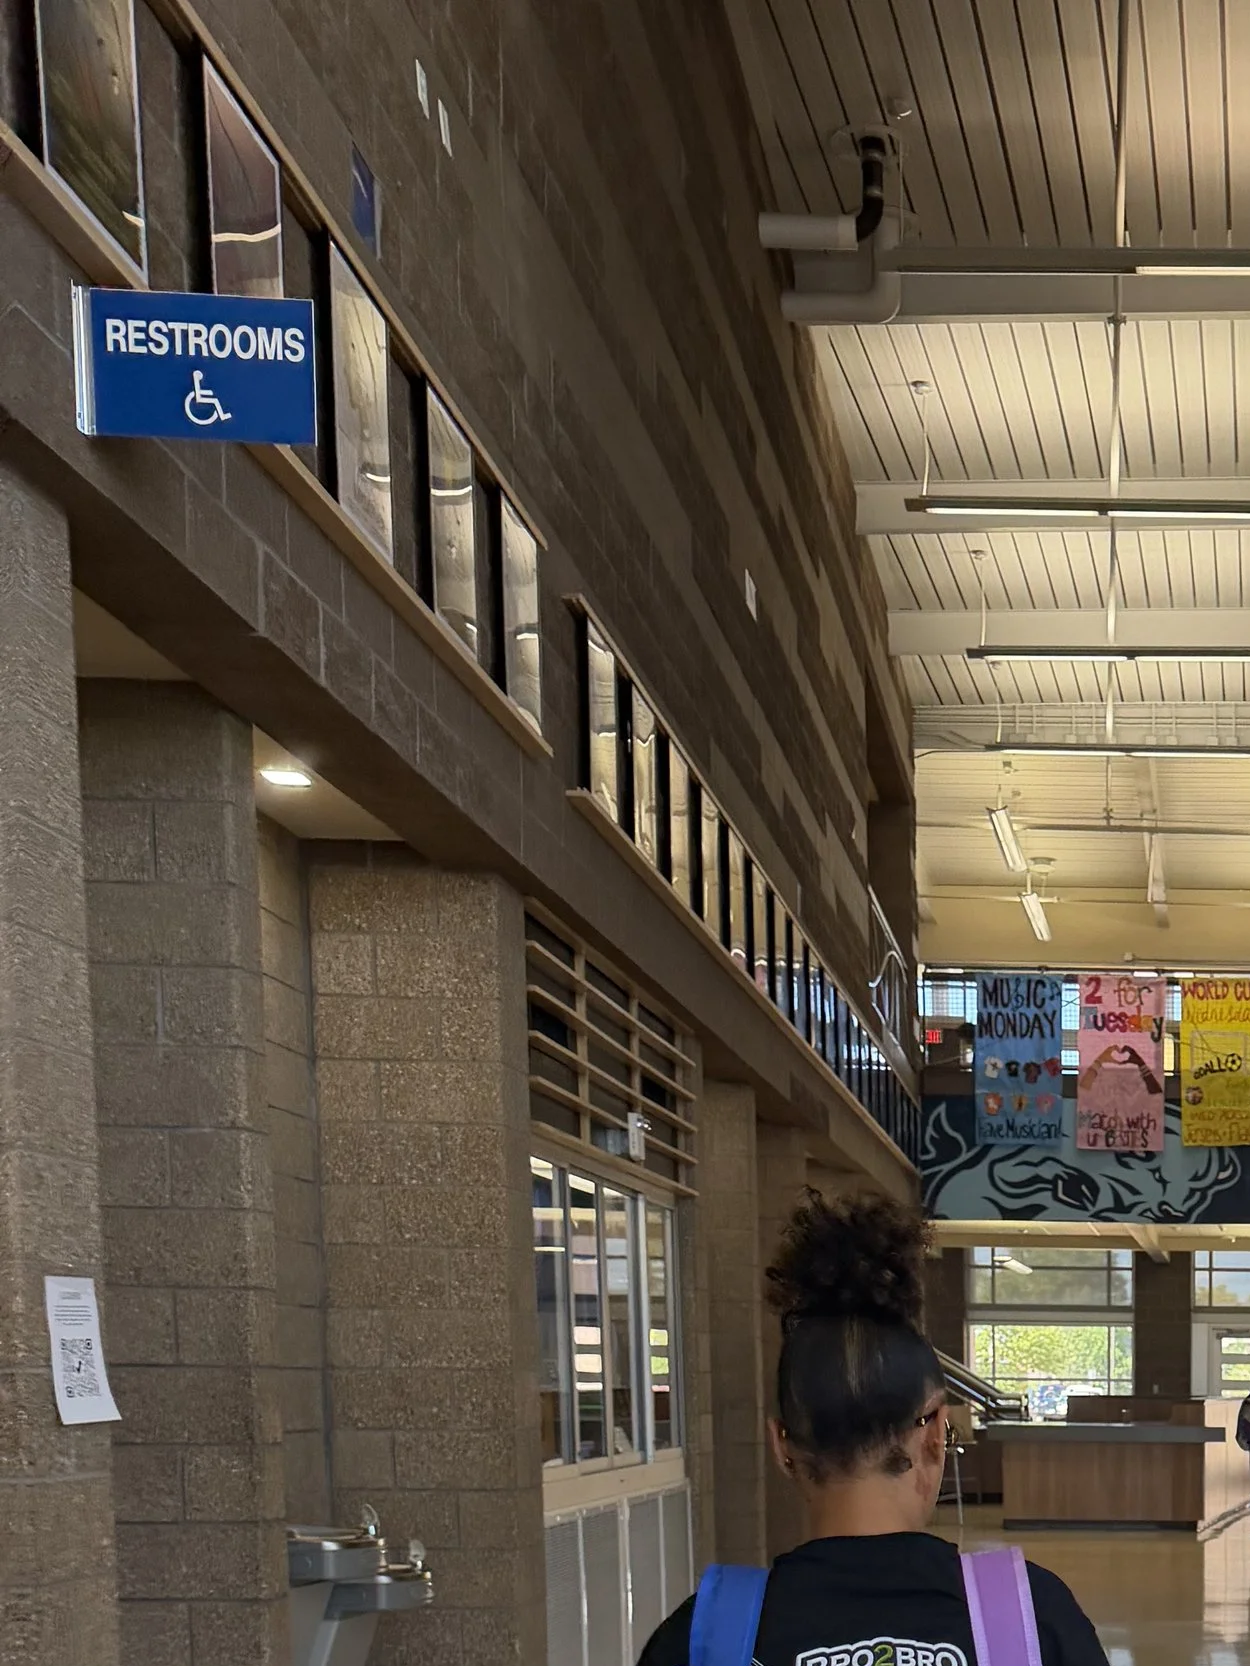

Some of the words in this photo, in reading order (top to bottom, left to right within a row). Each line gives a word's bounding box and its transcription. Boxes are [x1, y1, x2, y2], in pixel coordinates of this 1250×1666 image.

[105, 318, 306, 363] RESTROOMS
[1085, 976, 1103, 1005] 2
[1114, 977, 1152, 1007] for
[1181, 981, 1229, 1001] WORLD
[978, 1010, 1057, 1039] MONDAY
[1080, 1005, 1164, 1043] Tuesday
